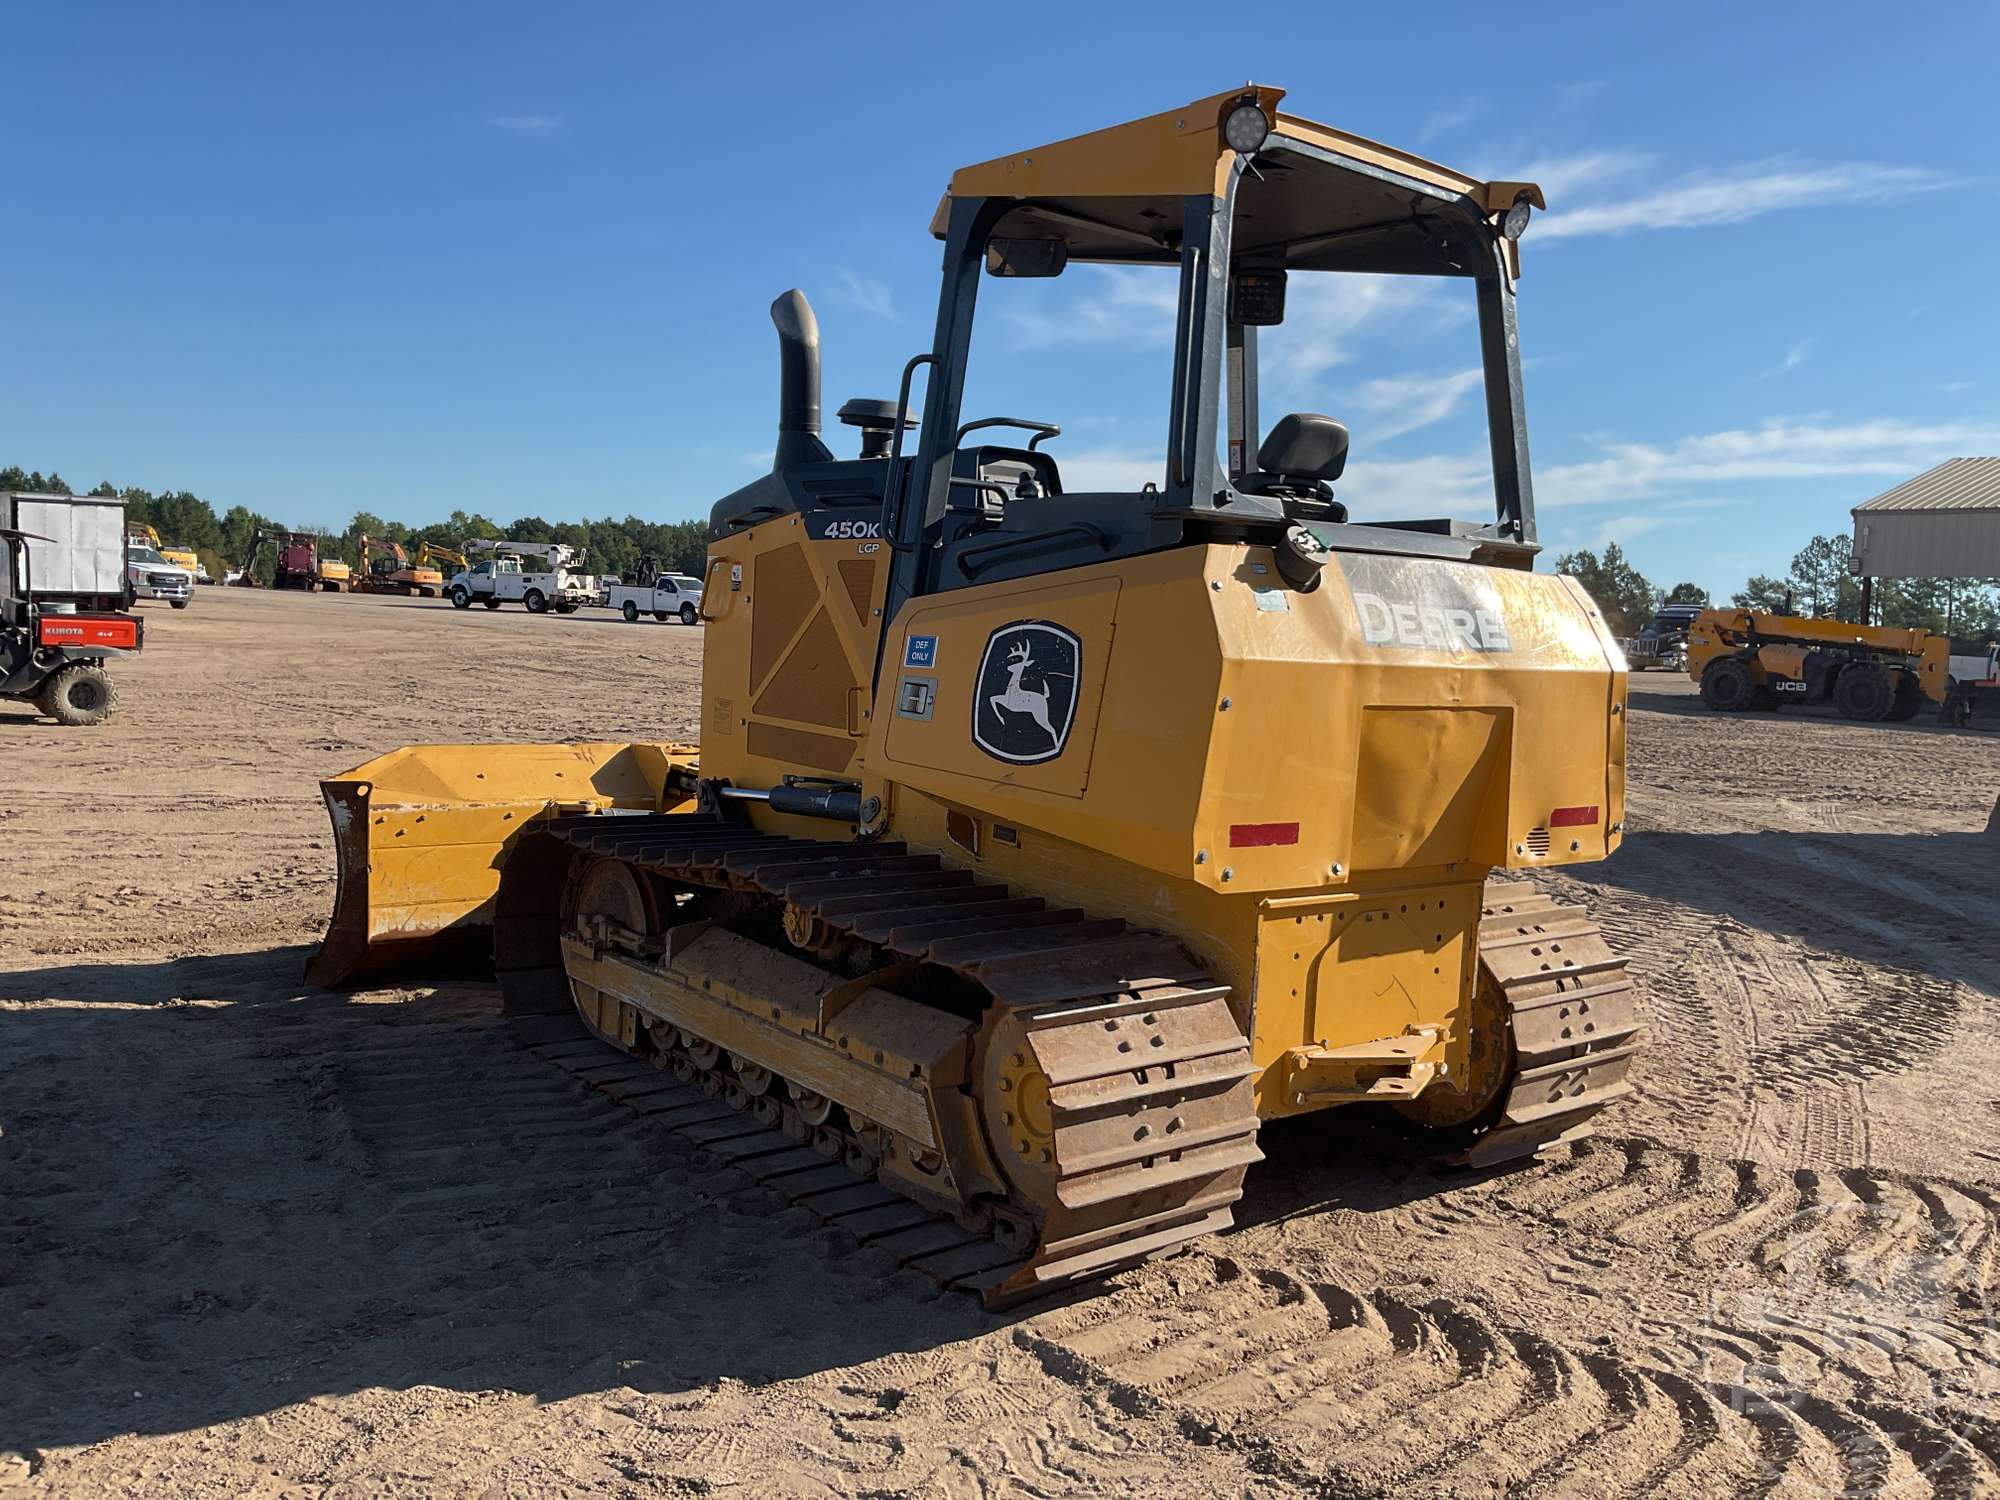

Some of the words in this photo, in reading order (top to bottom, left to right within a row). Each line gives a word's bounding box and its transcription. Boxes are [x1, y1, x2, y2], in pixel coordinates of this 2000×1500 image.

[824, 521, 880, 539] 450K
[858, 543, 880, 554] LGP
[1353, 592, 1512, 650] DEERE
[45, 627, 84, 636] KUBOTA
[915, 640, 929, 650] DEF
[911, 652, 929, 662] ONLY
[1776, 681, 1807, 692] JCB
